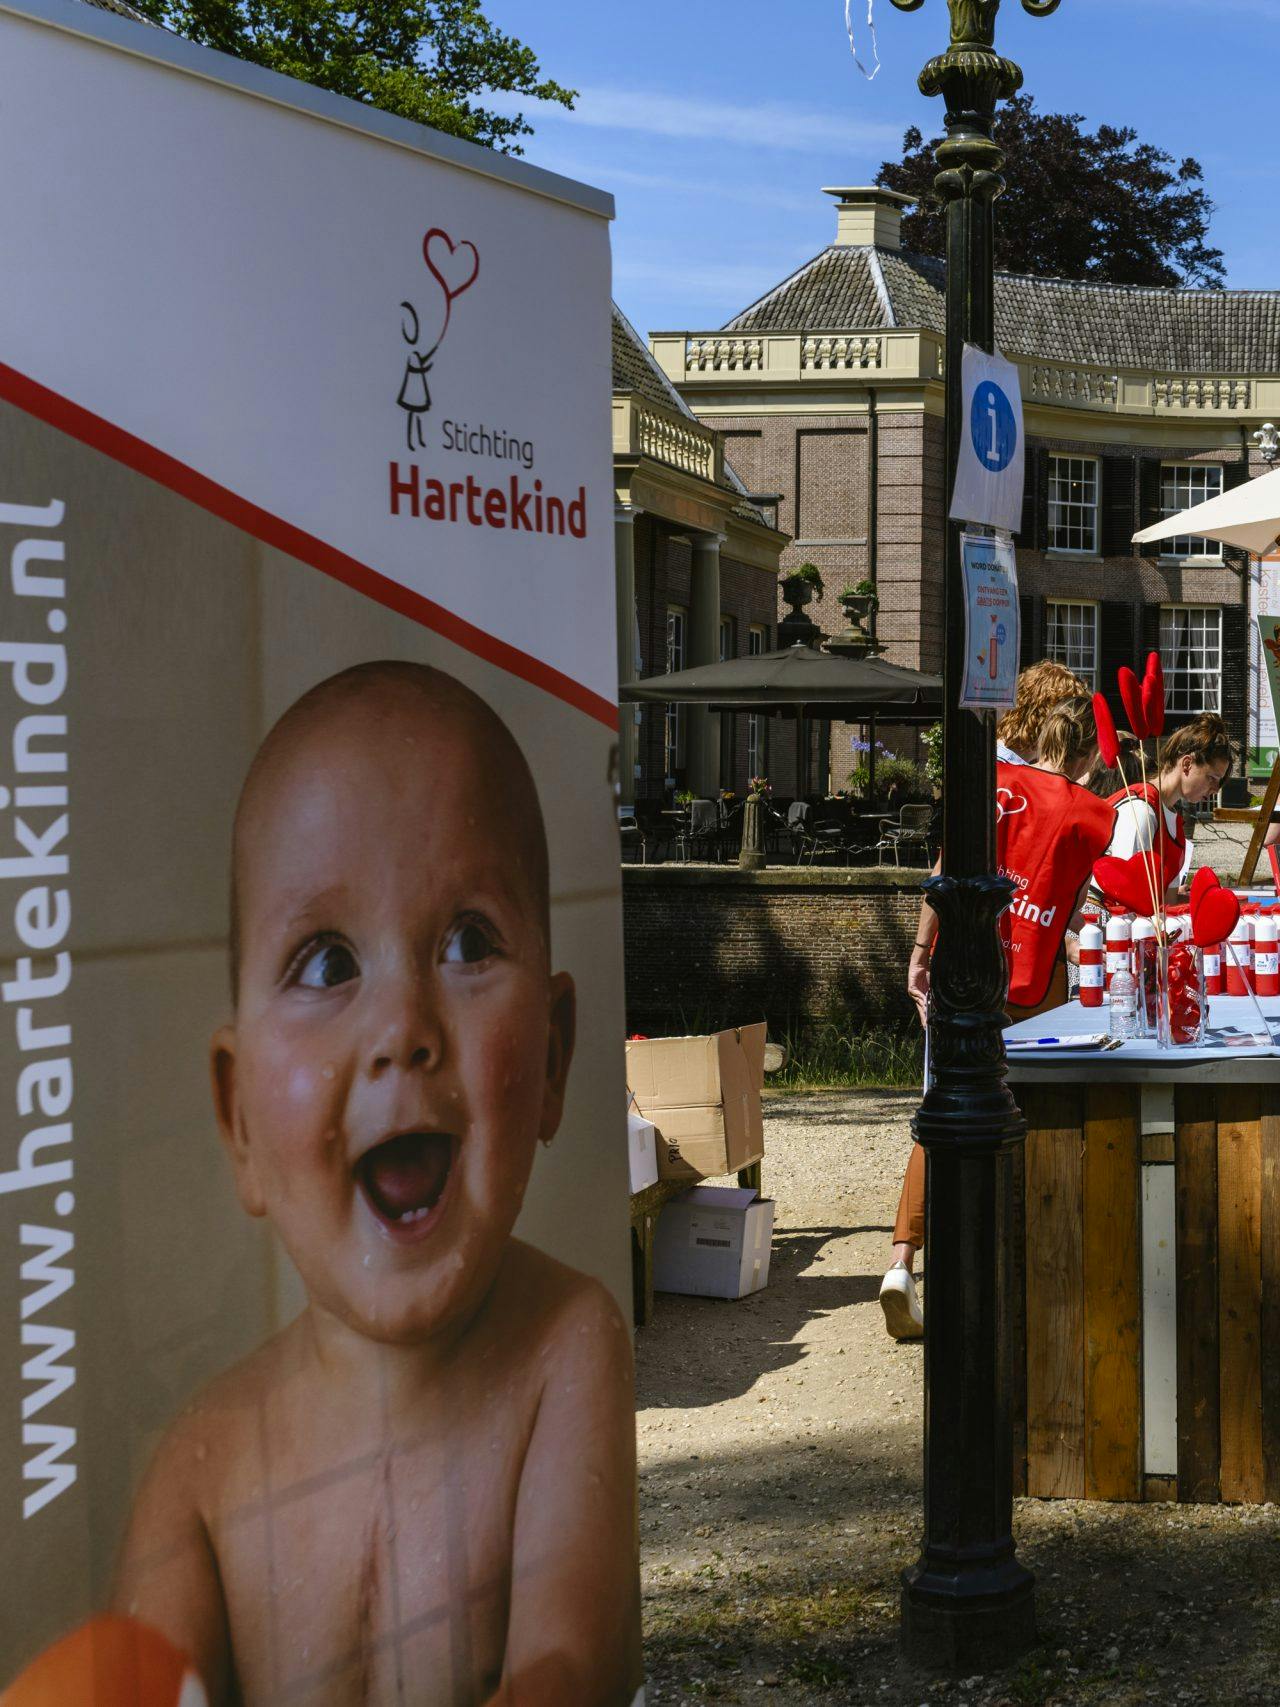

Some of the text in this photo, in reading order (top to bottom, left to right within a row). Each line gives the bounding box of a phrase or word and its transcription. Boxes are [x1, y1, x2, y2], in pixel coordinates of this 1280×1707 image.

[441, 420, 534, 470] Stichting
[389, 461, 587, 539] Hartekind
[1258, 568, 1271, 617] Kastee
[996, 863, 1029, 891] hting
[1001, 938, 1022, 953] d.nl
[0, 498, 79, 1519] www.hartekind.nl
[667, 1137, 683, 1165] PRIO
